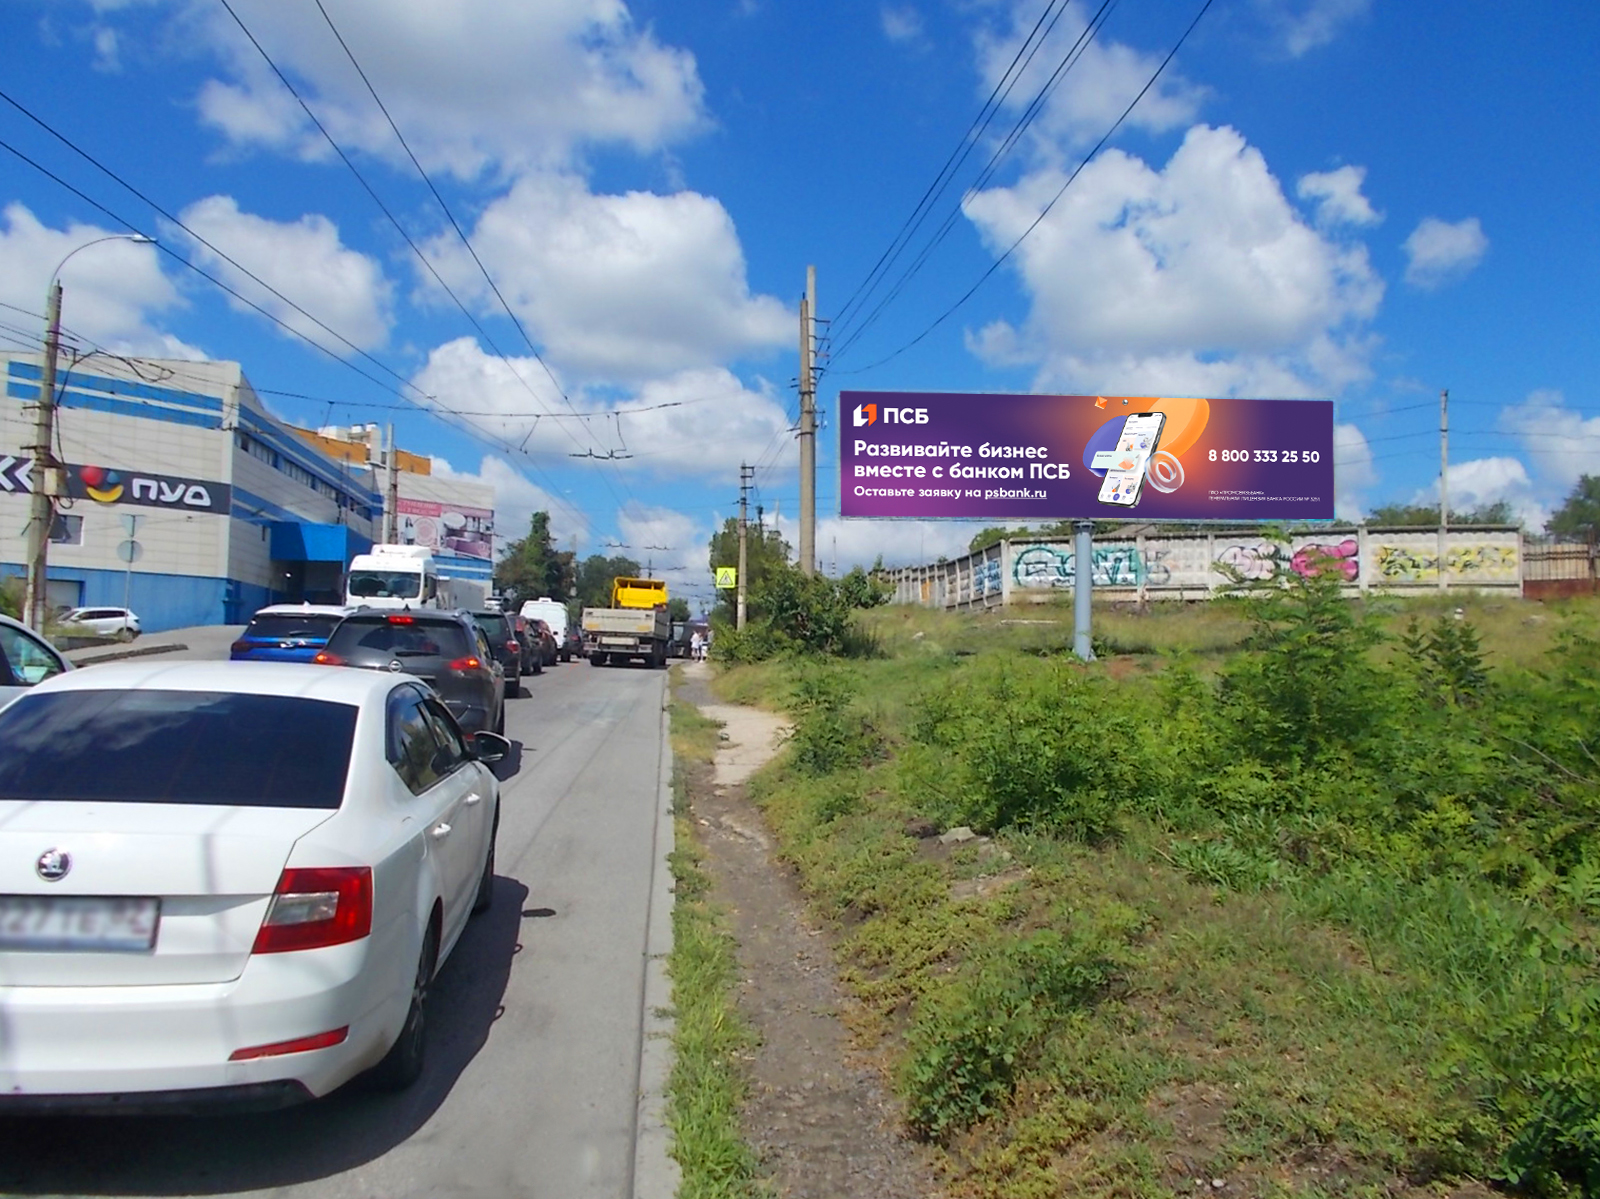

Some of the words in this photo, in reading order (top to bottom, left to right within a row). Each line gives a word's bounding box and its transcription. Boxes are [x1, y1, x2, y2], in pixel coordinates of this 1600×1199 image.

[883, 407, 930, 425] ПСБ
[854, 439, 973, 458] Развивайте
[978, 442, 1048, 459] бизнес
[1208, 449, 1218, 462] 8
[1221, 449, 1250, 463] 800
[1253, 449, 1278, 463] 333
[1281, 450, 1299, 463] 25
[1302, 450, 1320, 463] 50
[854, 465, 927, 478] вместе
[931, 466, 944, 479] с
[949, 463, 1024, 479] банком
[1030, 463, 1071, 480] ПСБ
[853, 485, 915, 497] Оставьте
[918, 488, 962, 500] заявку
[964, 489, 982, 498] на
[984, 487, 1048, 500] psbank.ru
